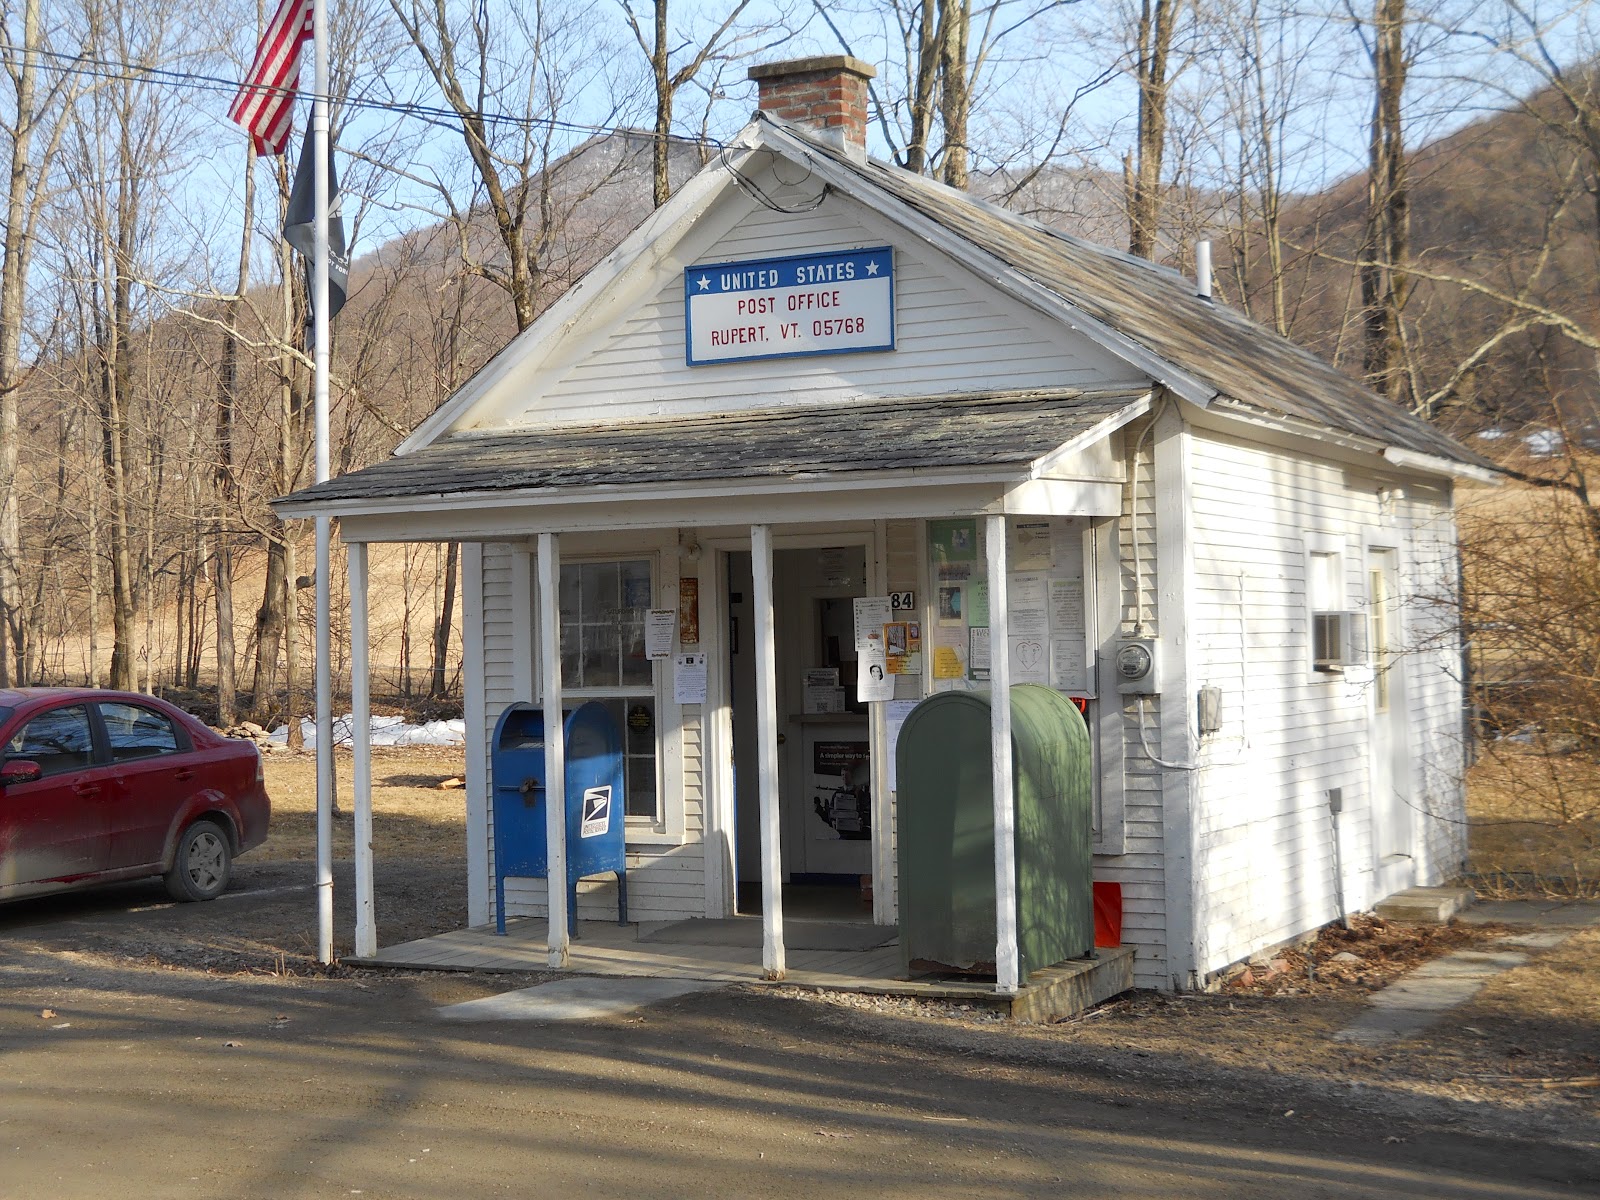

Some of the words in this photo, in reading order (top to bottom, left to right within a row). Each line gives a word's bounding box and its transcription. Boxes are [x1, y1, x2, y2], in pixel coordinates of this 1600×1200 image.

[720, 269, 779, 291] UNITED
[796, 262, 855, 283] STATES
[738, 297, 775, 315] POST
[788, 291, 840, 311] OFFICE
[711, 325, 769, 346] RUPERT,
[780, 323, 801, 339] VT.
[813, 317, 865, 337] 05768
[891, 593, 912, 608] 84
[825, 752, 844, 760] simpler
